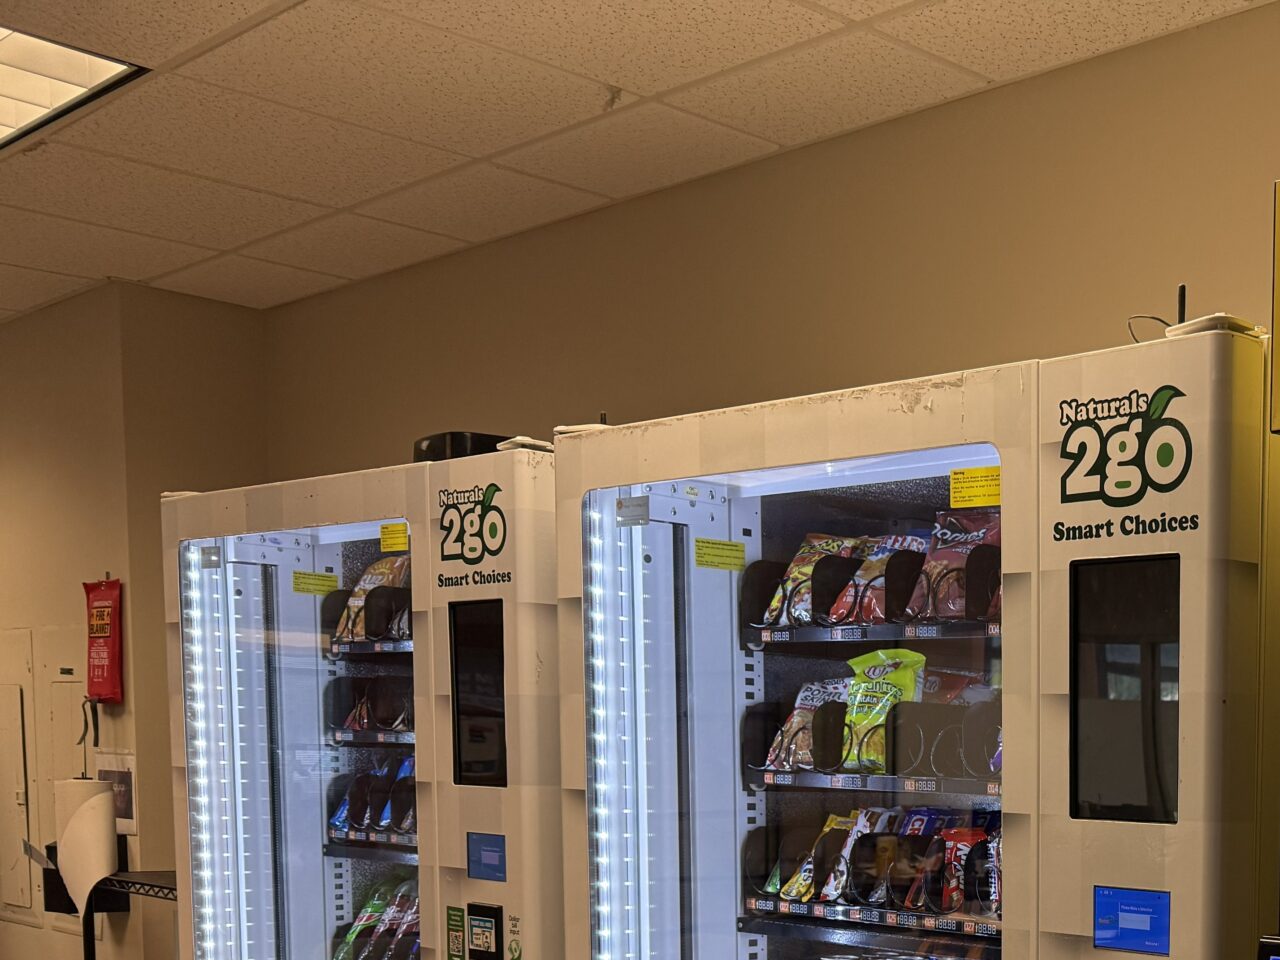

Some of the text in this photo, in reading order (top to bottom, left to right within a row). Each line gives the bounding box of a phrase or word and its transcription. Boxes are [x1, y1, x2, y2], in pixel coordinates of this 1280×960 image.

[1060, 389, 1149, 425] Naturals
[1061, 417, 1193, 507] 2go
[439, 485, 484, 507] Naturals
[440, 504, 507, 565] 2go
[1053, 513, 1199, 541] Smart Choices
[438, 570, 512, 588] Smart Choices
